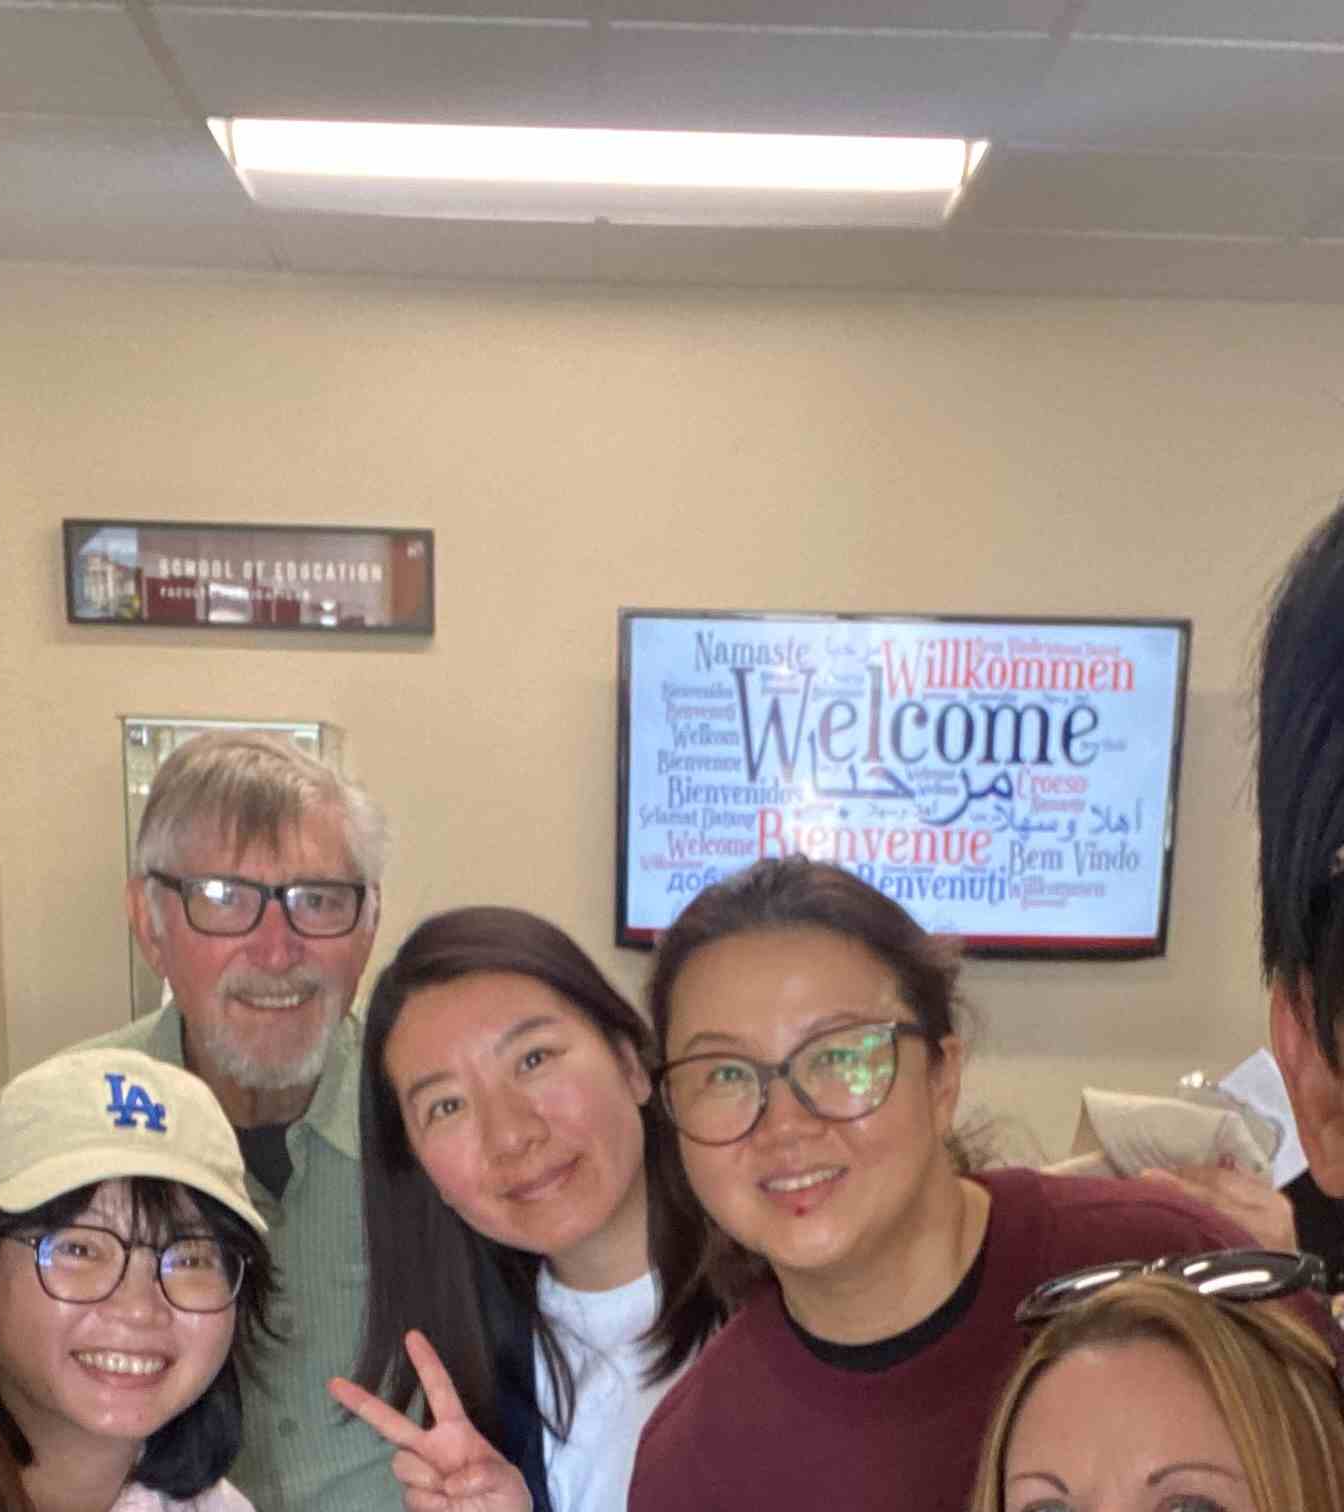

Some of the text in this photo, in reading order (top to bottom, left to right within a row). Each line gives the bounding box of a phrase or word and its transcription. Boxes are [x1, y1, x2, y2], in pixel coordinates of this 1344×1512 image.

[274, 561, 384, 584] EDUCATION
[694, 630, 811, 672] Namaste
[880, 636, 1137, 700] Willkommen
[730, 664, 1101, 783] Welcome
[667, 775, 804, 809] Bienvenidos
[1016, 765, 1088, 800] Croeso
[757, 805, 993, 865] Bienvenue
[1009, 839, 1141, 877] Bem Vindo
[858, 863, 1007, 907] Benvenuti
[104, 1073, 167, 1134] LA
